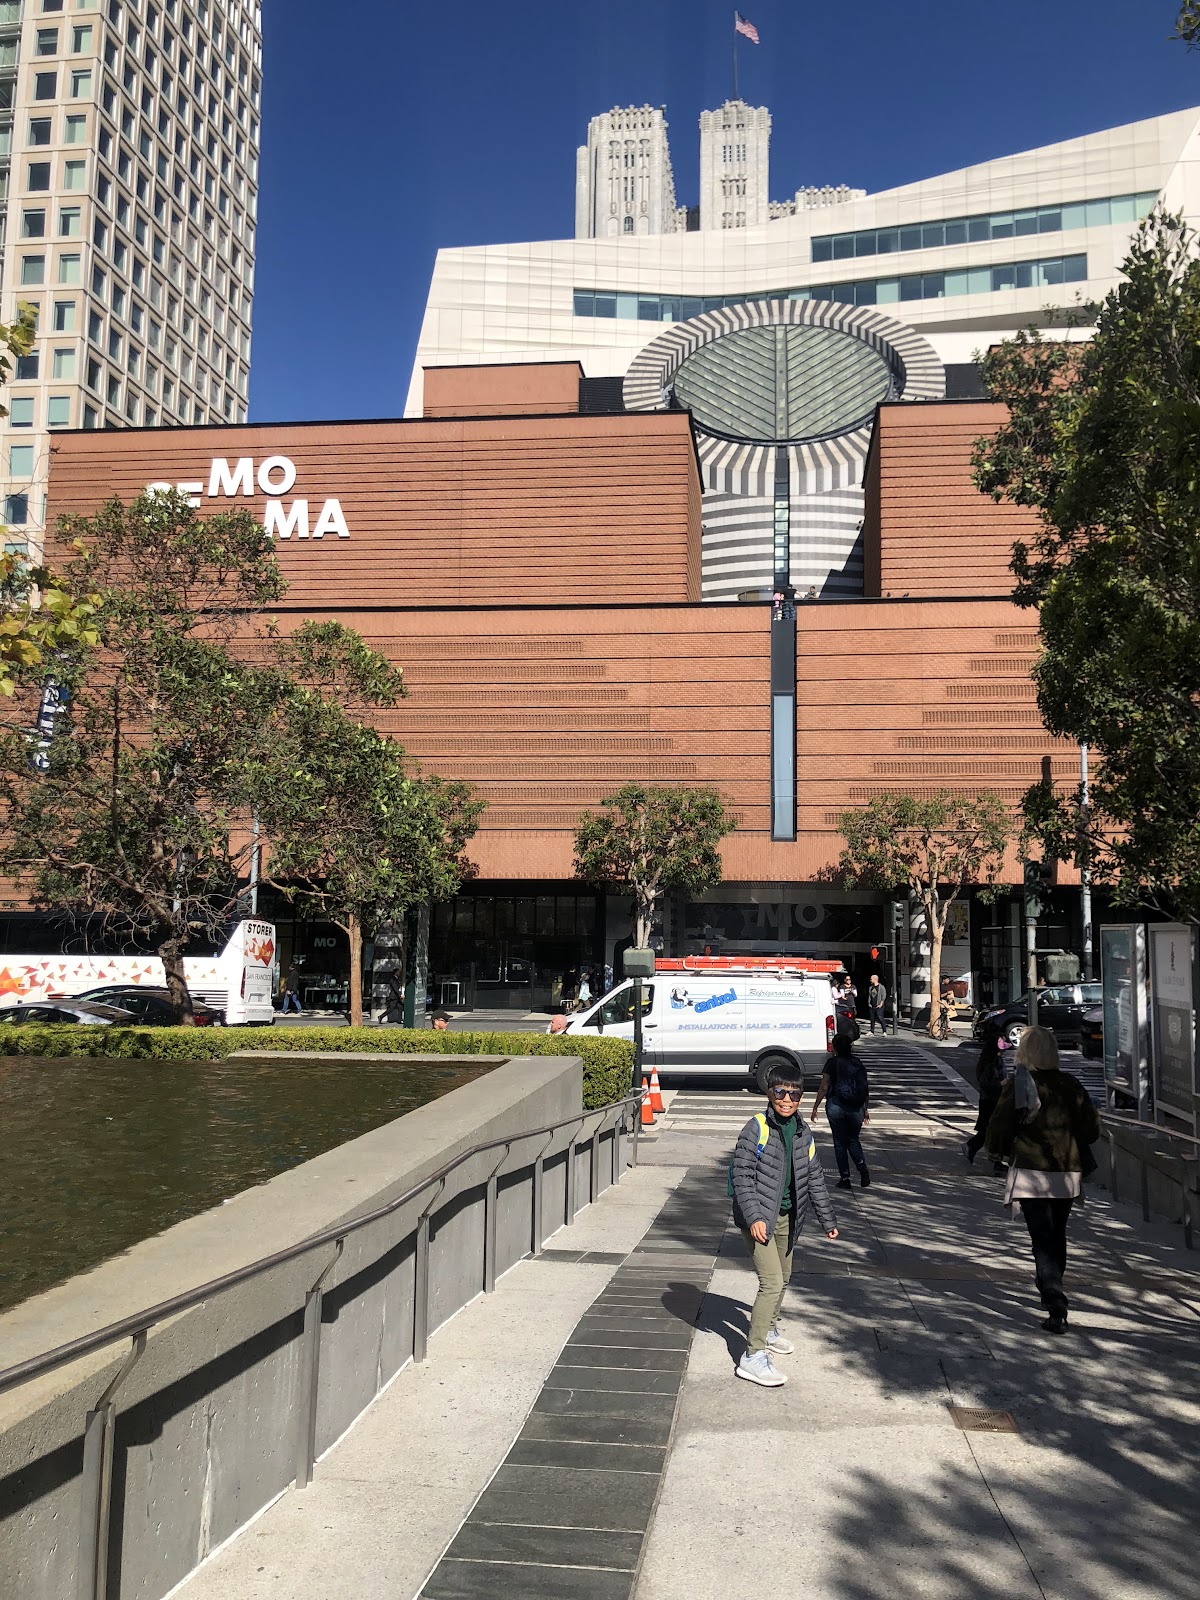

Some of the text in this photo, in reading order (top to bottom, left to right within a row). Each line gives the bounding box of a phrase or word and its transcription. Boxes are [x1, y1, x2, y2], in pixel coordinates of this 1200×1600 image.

[208, 456, 297, 497] MO
[264, 498, 351, 539] MA
[757, 903, 826, 929] MO
[247, 922, 273, 937] STORER
[313, 937, 337, 948] MO
[292, 954, 307, 965] SF
[325, 993, 348, 1004] MA
[694, 987, 738, 1014] central
[748, 988, 796, 998] Refrigeration
[798, 989, 813, 998] Co.
[677, 1022, 813, 1031] INSTALLATIONS SALES SERVICE
